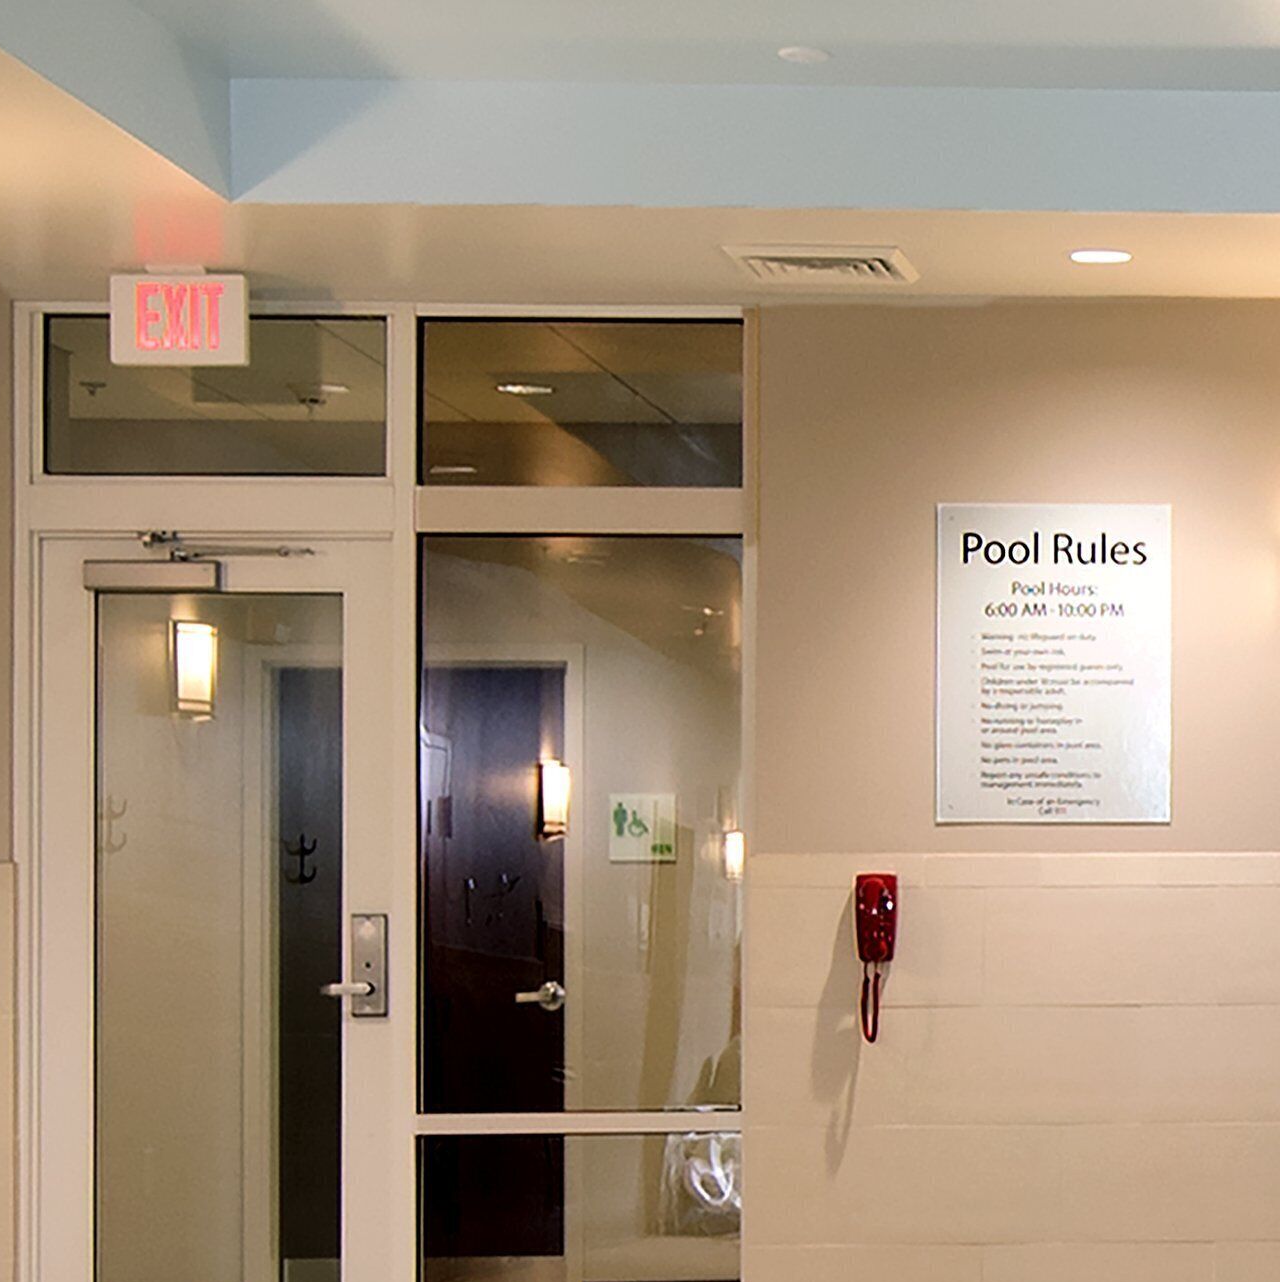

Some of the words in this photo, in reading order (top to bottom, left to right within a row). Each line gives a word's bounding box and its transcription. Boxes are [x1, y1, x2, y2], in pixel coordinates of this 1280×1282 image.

[135, 282, 224, 350] EXIT
[962, 531, 1039, 565] Pool
[1053, 532, 1147, 565] Rules
[1011, 581, 1045, 596] Pool
[984, 603, 1018, 617] 6:00
[1021, 603, 1048, 616] AM
[1058, 603, 1096, 617] 10:00
[1100, 603, 1125, 616] PM
